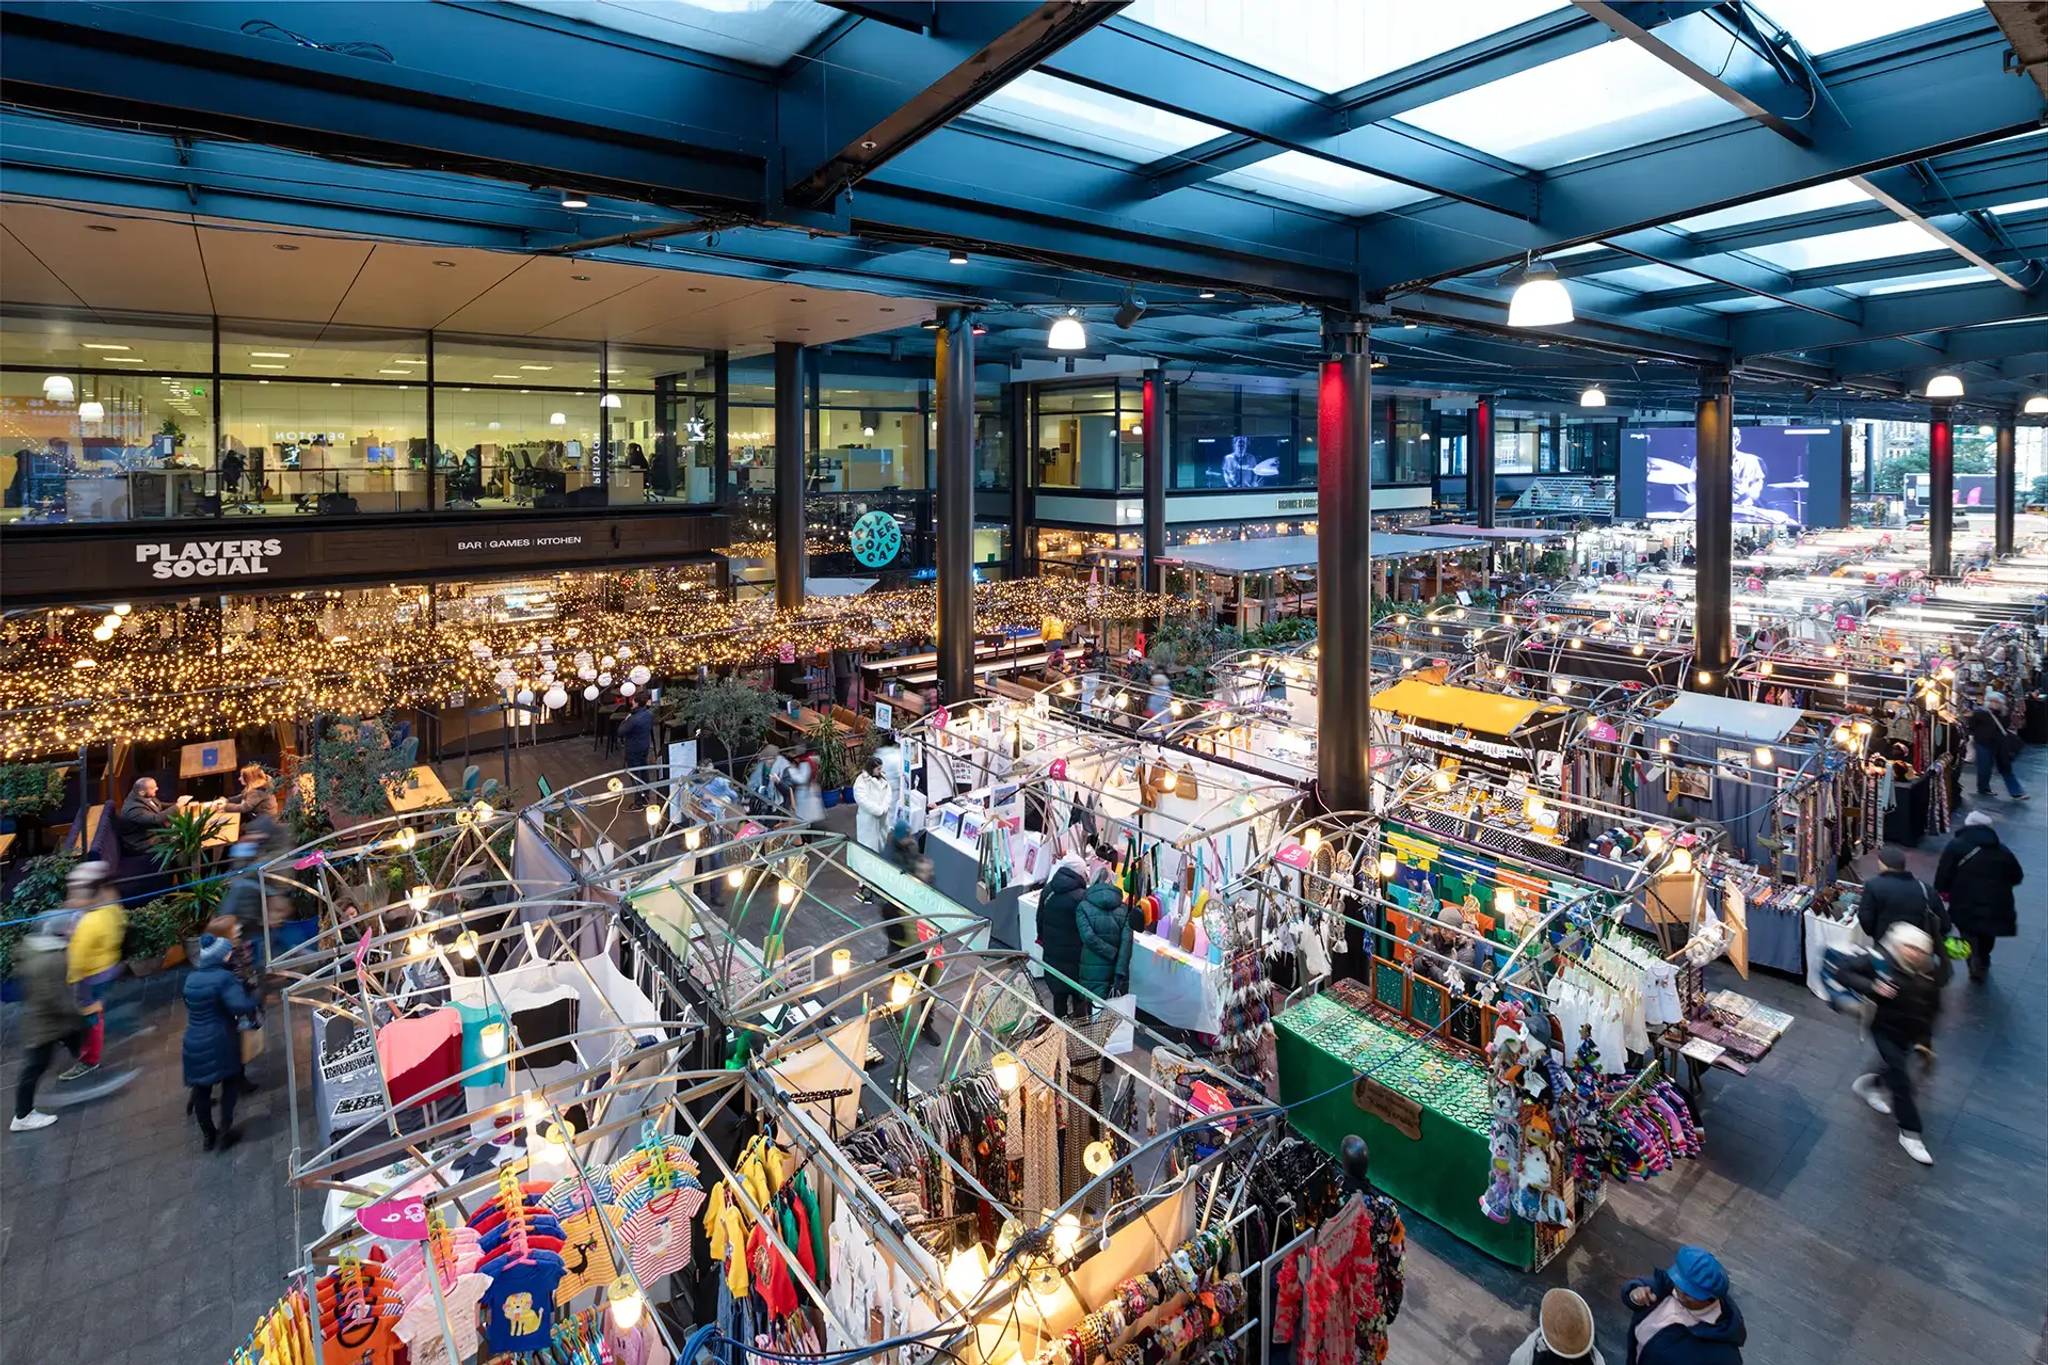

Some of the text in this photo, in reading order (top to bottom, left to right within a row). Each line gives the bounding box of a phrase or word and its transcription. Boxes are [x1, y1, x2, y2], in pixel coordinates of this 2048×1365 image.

[136, 539, 282, 562] PLAYERS
[458, 536, 582, 550] BAR GAMES KITCHEN
[152, 557, 268, 579] SOCIAL
